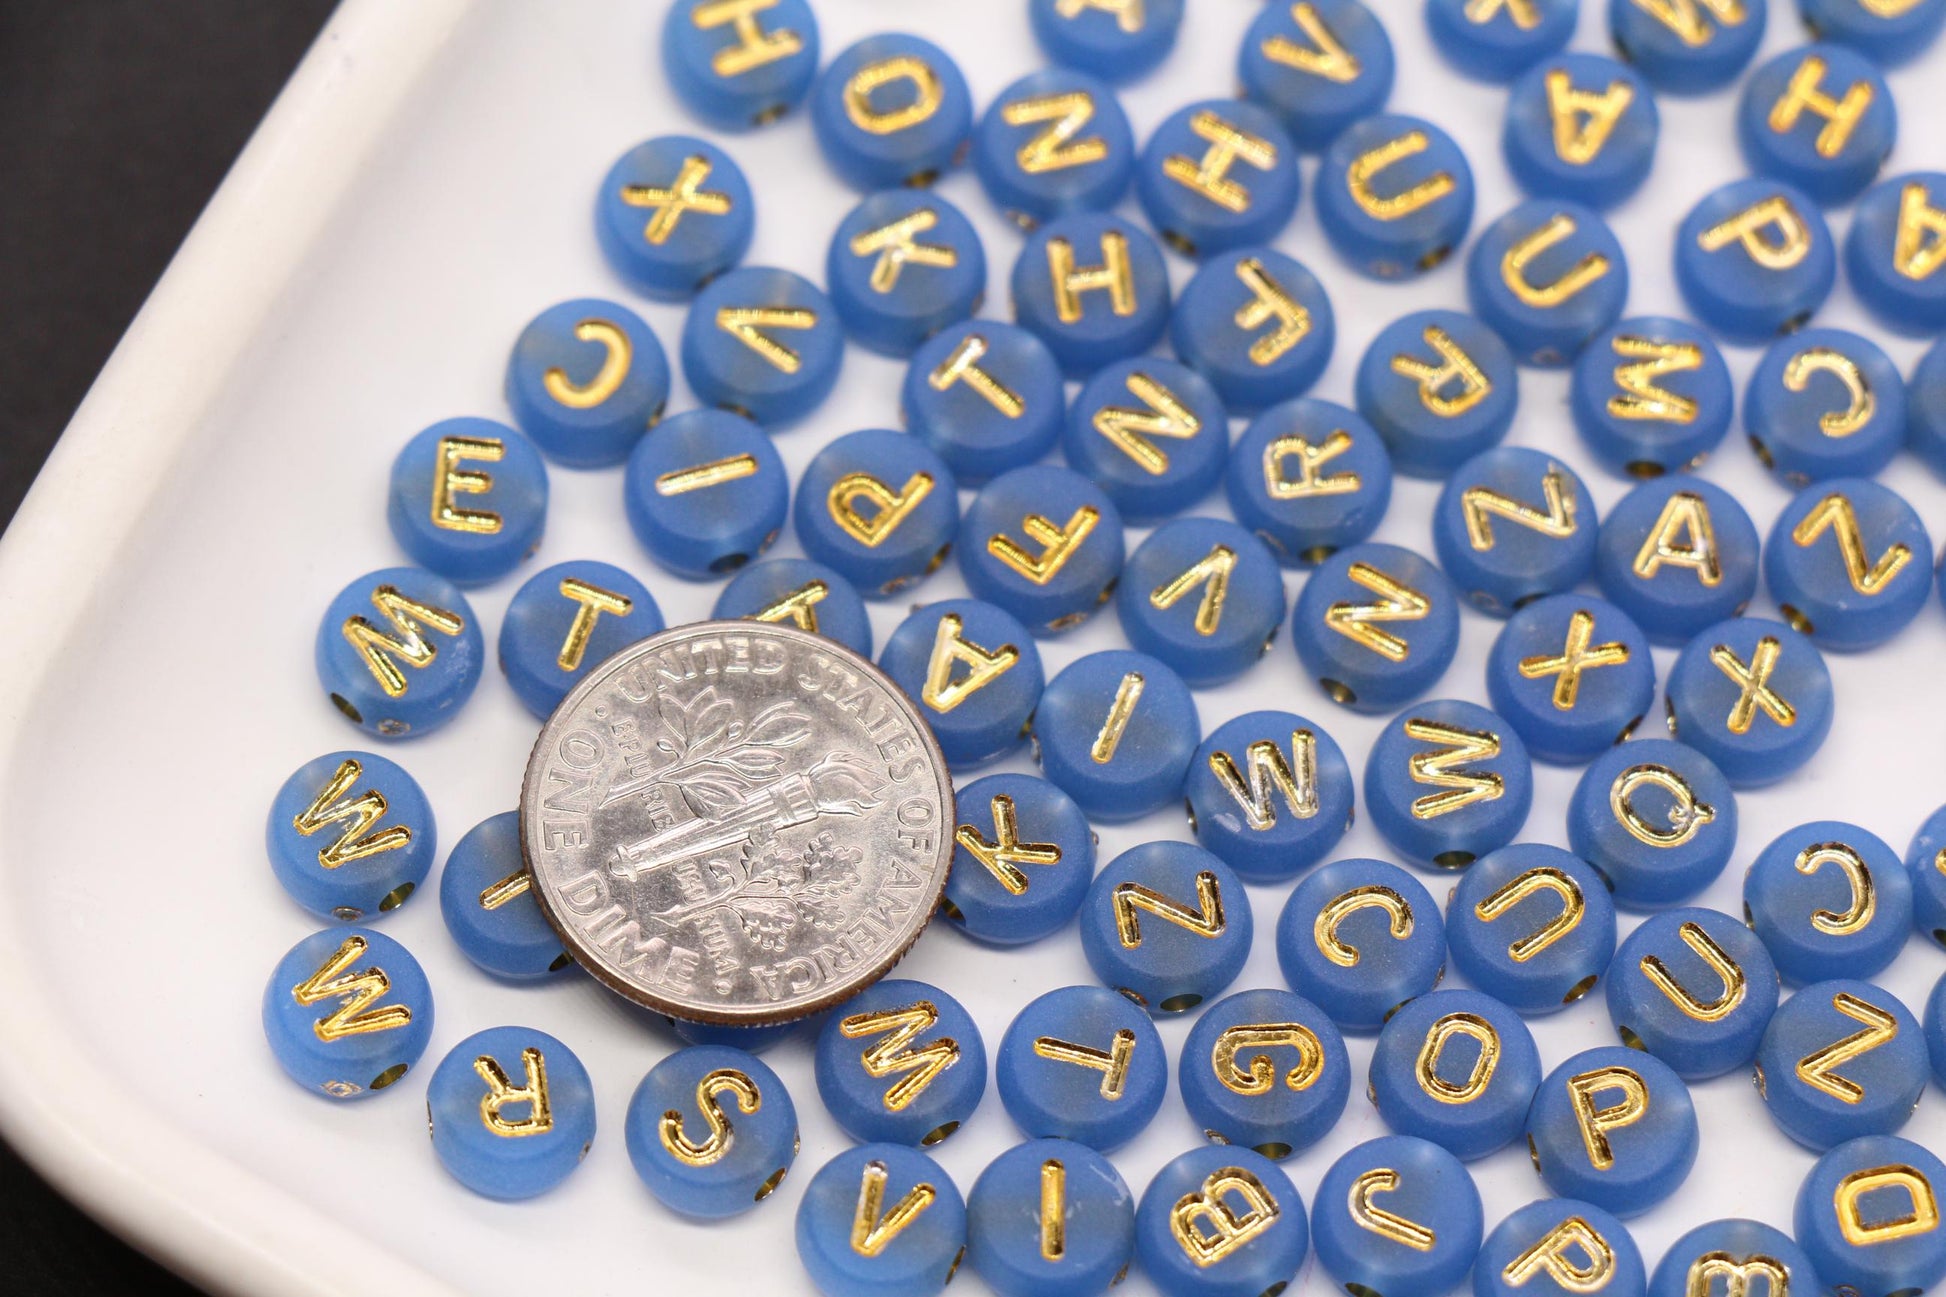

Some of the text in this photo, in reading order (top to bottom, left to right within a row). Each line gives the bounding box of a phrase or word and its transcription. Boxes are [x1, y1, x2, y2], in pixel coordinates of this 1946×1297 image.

[692, 0, 800, 76] H
[1263, 0, 1358, 82] V
[845, 57, 942, 134] O
[1546, 70, 1632, 164] A
[1769, 57, 1873, 158] H
[621, 157, 730, 244] X
[1164, 112, 1276, 212] H
[1348, 132, 1454, 220] U
[852, 210, 956, 292] K
[1047, 232, 1136, 323] H
[1502, 216, 1609, 307] U
[1700, 197, 1810, 269] P
[1894, 184, 1946, 280] A
[717, 304, 817, 373] V
[1235, 260, 1312, 366] F
[544, 319, 632, 408] C
[930, 337, 1024, 418] T
[1391, 327, 1491, 417] R
[1784, 348, 1874, 437] C
[1093, 374, 1201, 475] N
[1265, 430, 1361, 499] R
[431, 437, 505, 534] E
[656, 454, 758, 495] I
[827, 472, 935, 548] P
[987, 505, 1100, 585] F
[1633, 493, 1723, 587] A
[1792, 494, 1912, 595] Z
[558, 578, 632, 671] T
[1150, 546, 1237, 636] V
[615, 636, 787, 703] UNITED
[922, 613, 1019, 713] A
[1519, 611, 1630, 710] X
[1711, 637, 1796, 734] X
[798, 663, 922, 785] STATES
[1091, 675, 1144, 764] I
[293, 759, 412, 869] W
[1209, 729, 1318, 830] W
[1611, 764, 1714, 848] Q
[542, 728, 700, 996] ONE DIME
[896, 798, 934, 856] OF
[956, 793, 1062, 895] K
[748, 856, 925, 999] AMERICA
[1314, 886, 1413, 967] C
[1475, 867, 1585, 963] U
[1796, 843, 1876, 935] C
[293, 936, 411, 1042] W
[1640, 922, 1745, 1022] U
[474, 1048, 553, 1137] R
[1033, 1029, 1135, 1100] T
[1212, 1022, 1325, 1096] G
[1415, 1012, 1501, 1104] O
[1795, 992, 1898, 1104] Z
[659, 1068, 761, 1167] S
[1567, 1066, 1650, 1170] P
[850, 1163, 935, 1257] V
[1040, 1159, 1065, 1262] I
[1170, 1167, 1279, 1267] B
[1350, 1168, 1436, 1251] J
[1833, 1164, 1940, 1246] D
[1502, 1217, 1616, 1293] P
